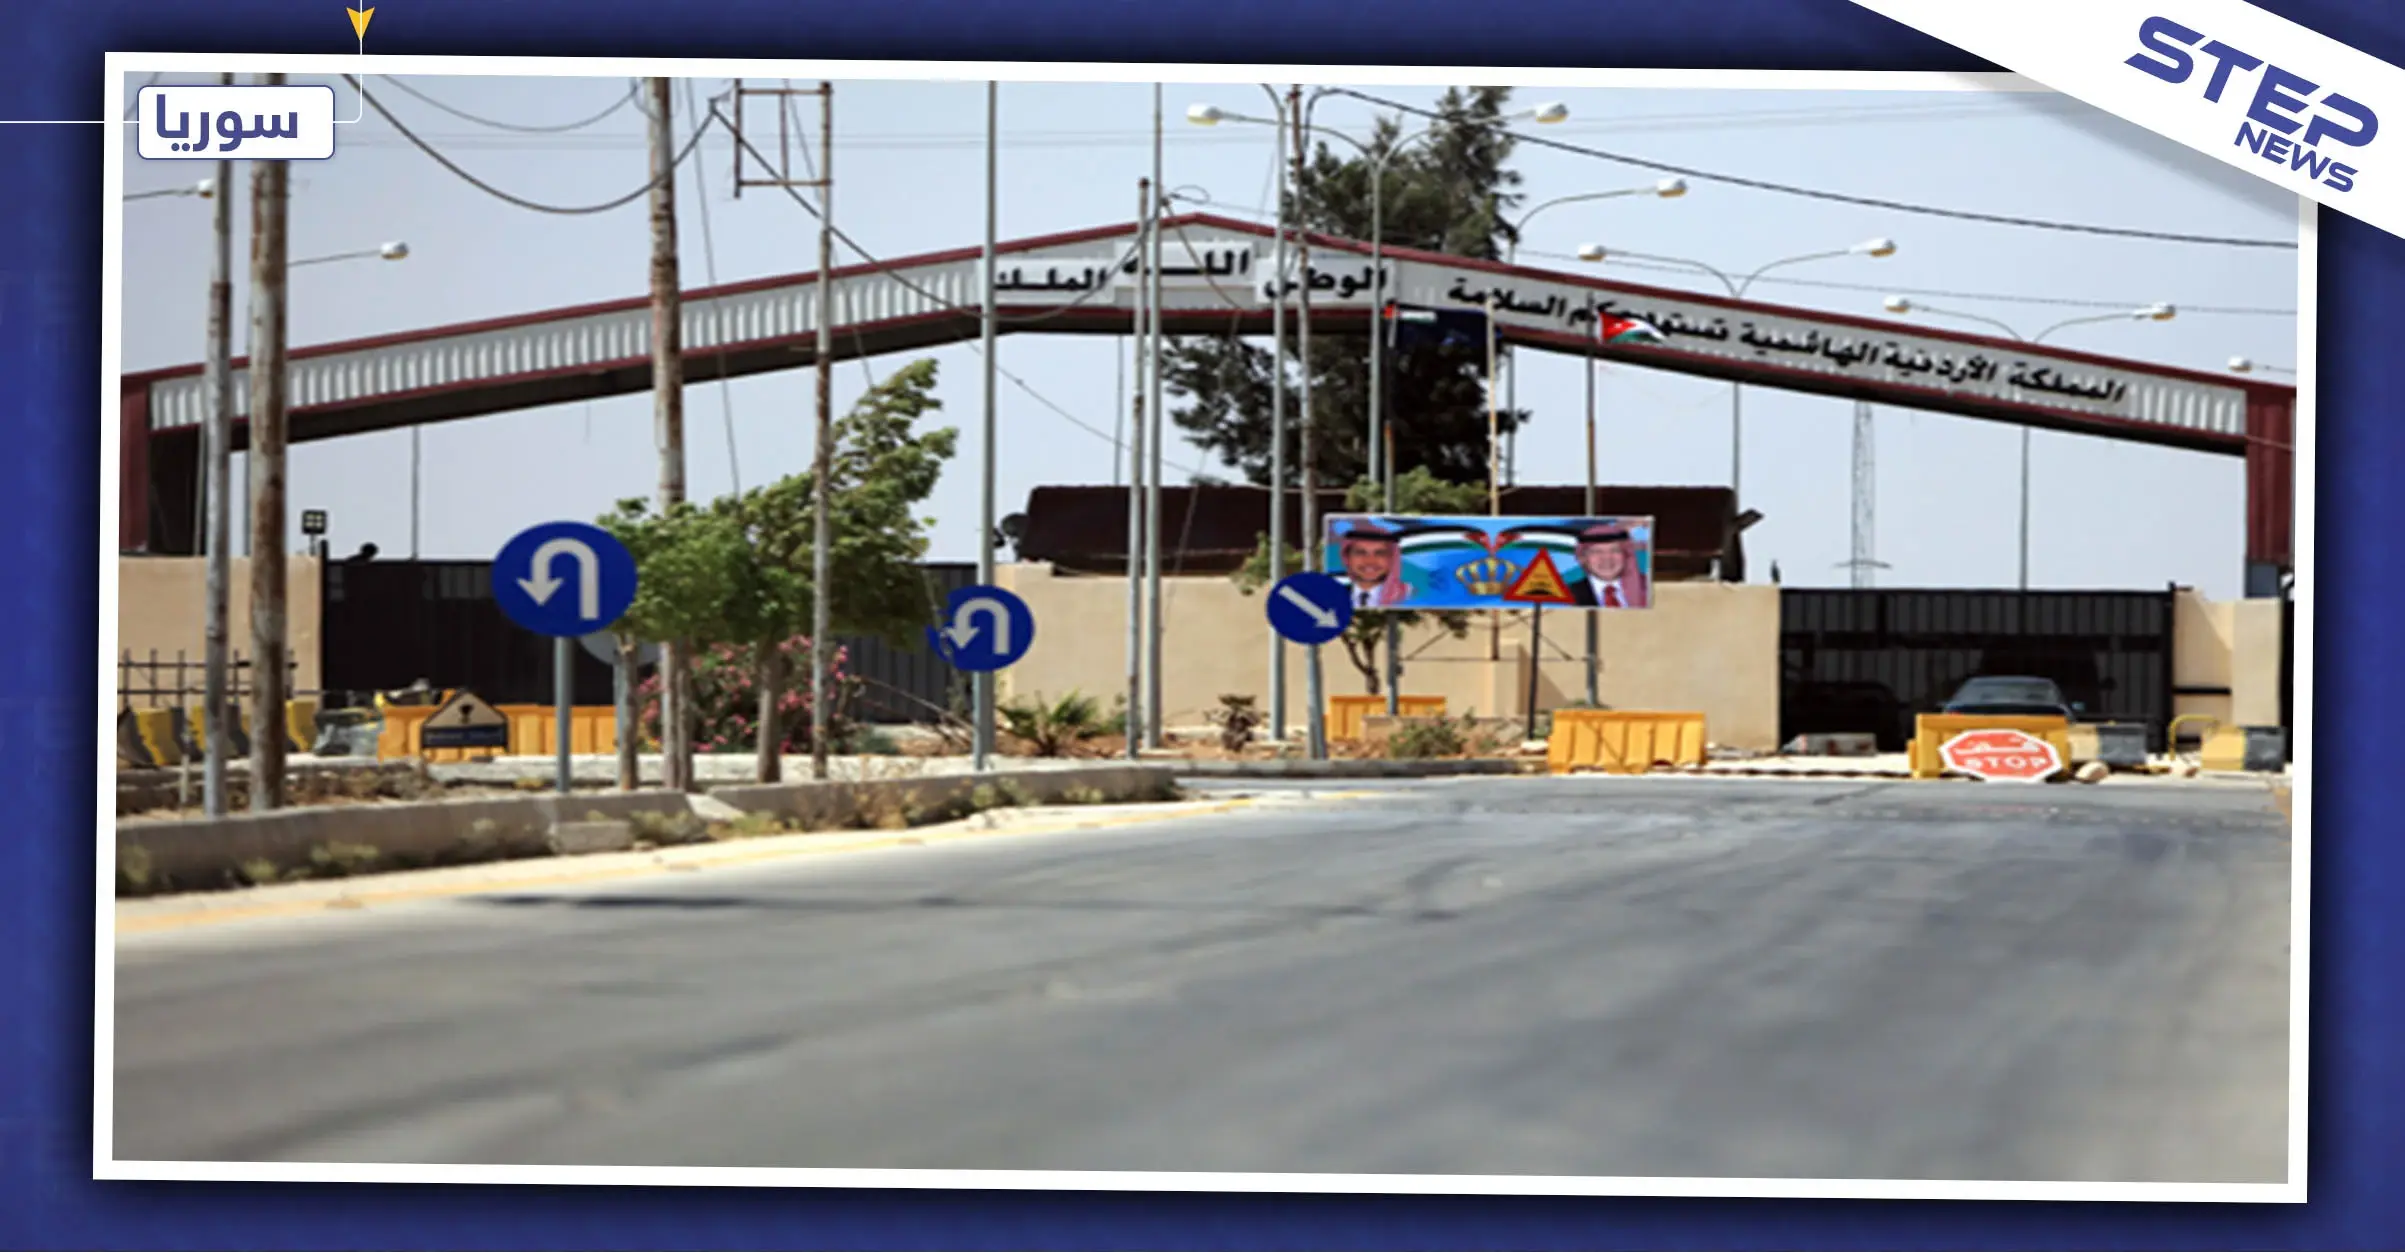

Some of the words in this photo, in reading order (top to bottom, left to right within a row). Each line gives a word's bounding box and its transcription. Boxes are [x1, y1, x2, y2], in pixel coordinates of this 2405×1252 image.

[1447, 277, 1567, 317] السلامة
[1739, 322, 1880, 367] الهاشمية
[1883, 341, 1998, 383] الأردنية
[2008, 362, 2127, 402] المملكة
[1964, 755, 2048, 770] STOP
